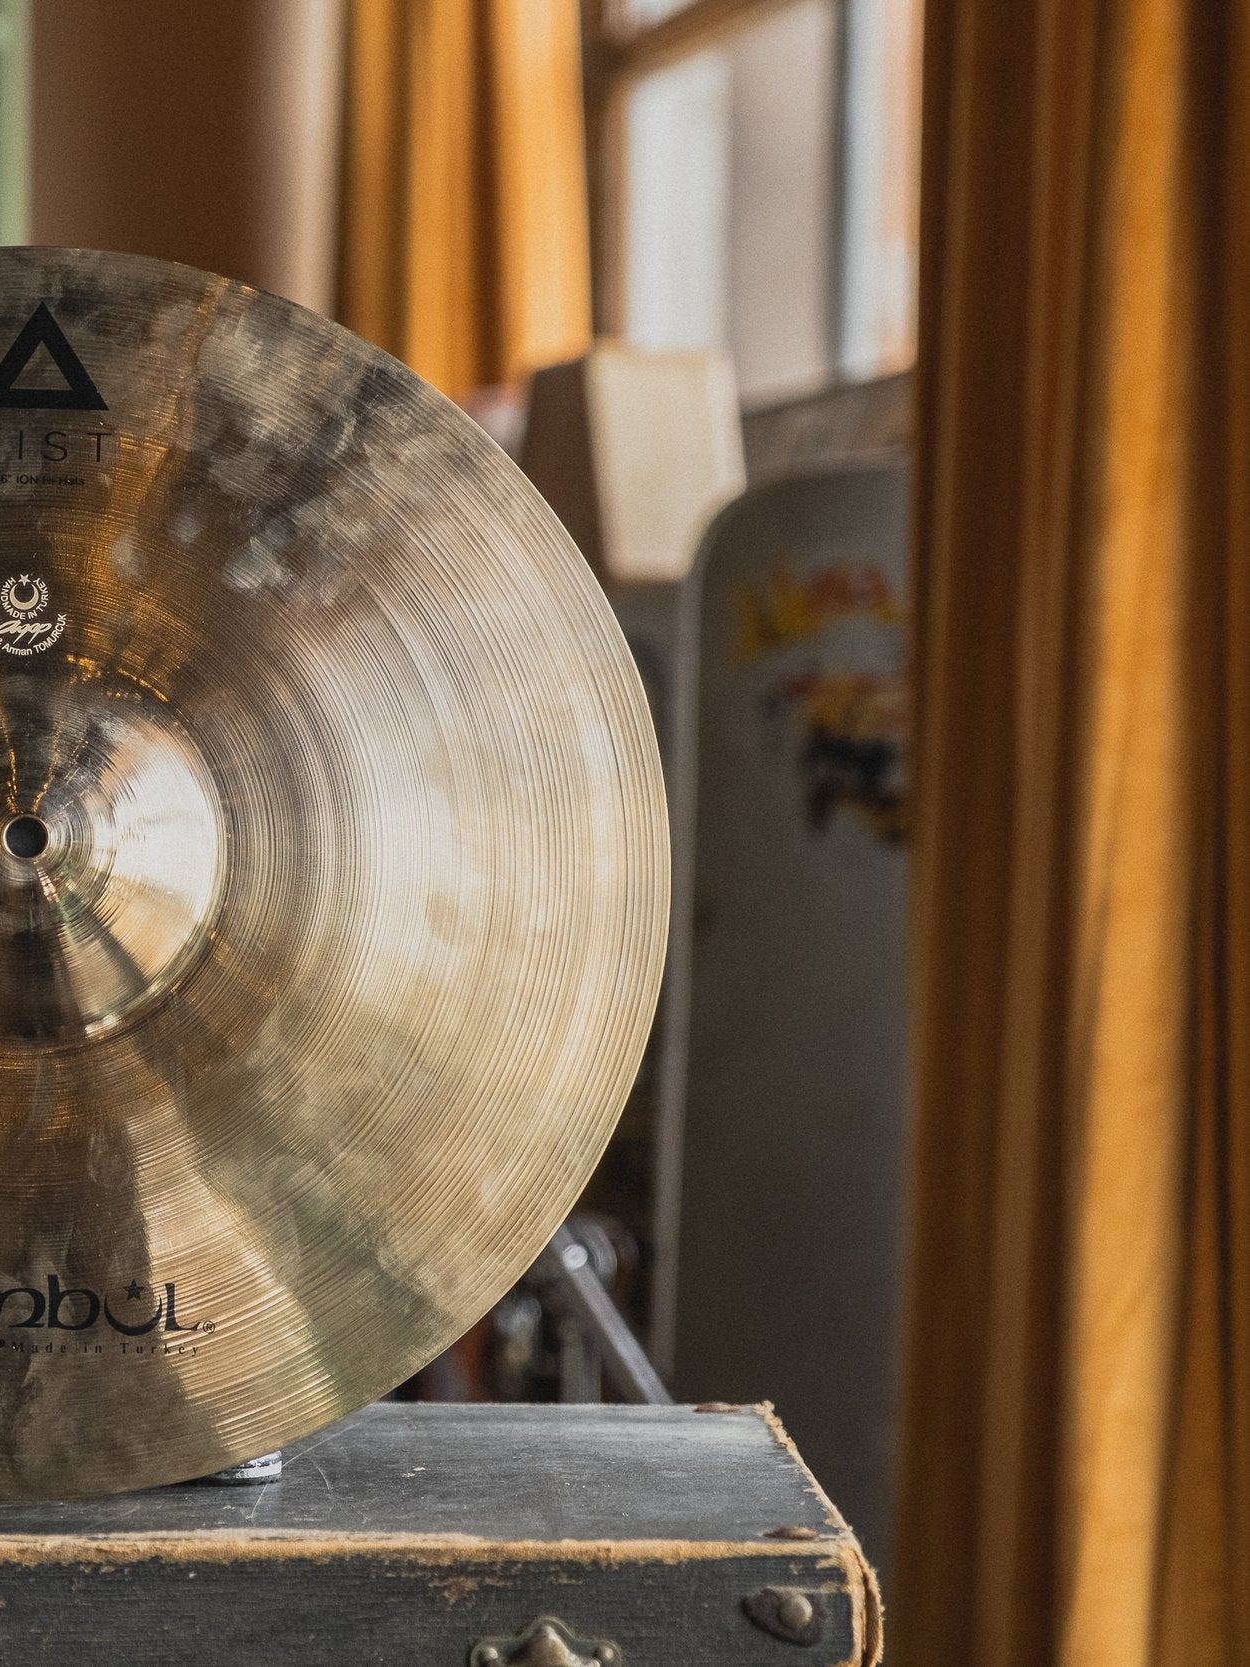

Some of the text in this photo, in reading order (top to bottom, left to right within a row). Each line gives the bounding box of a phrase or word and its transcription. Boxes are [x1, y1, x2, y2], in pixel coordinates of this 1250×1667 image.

[16, 474, 38, 485] ION
[0, 577, 49, 620] HANDMADE IN TURKEY
[2, 643, 33, 656] Arman
[33, 613, 67, 654] TOMURCUK
[12, 1341, 200, 1357] Made in Turkey
